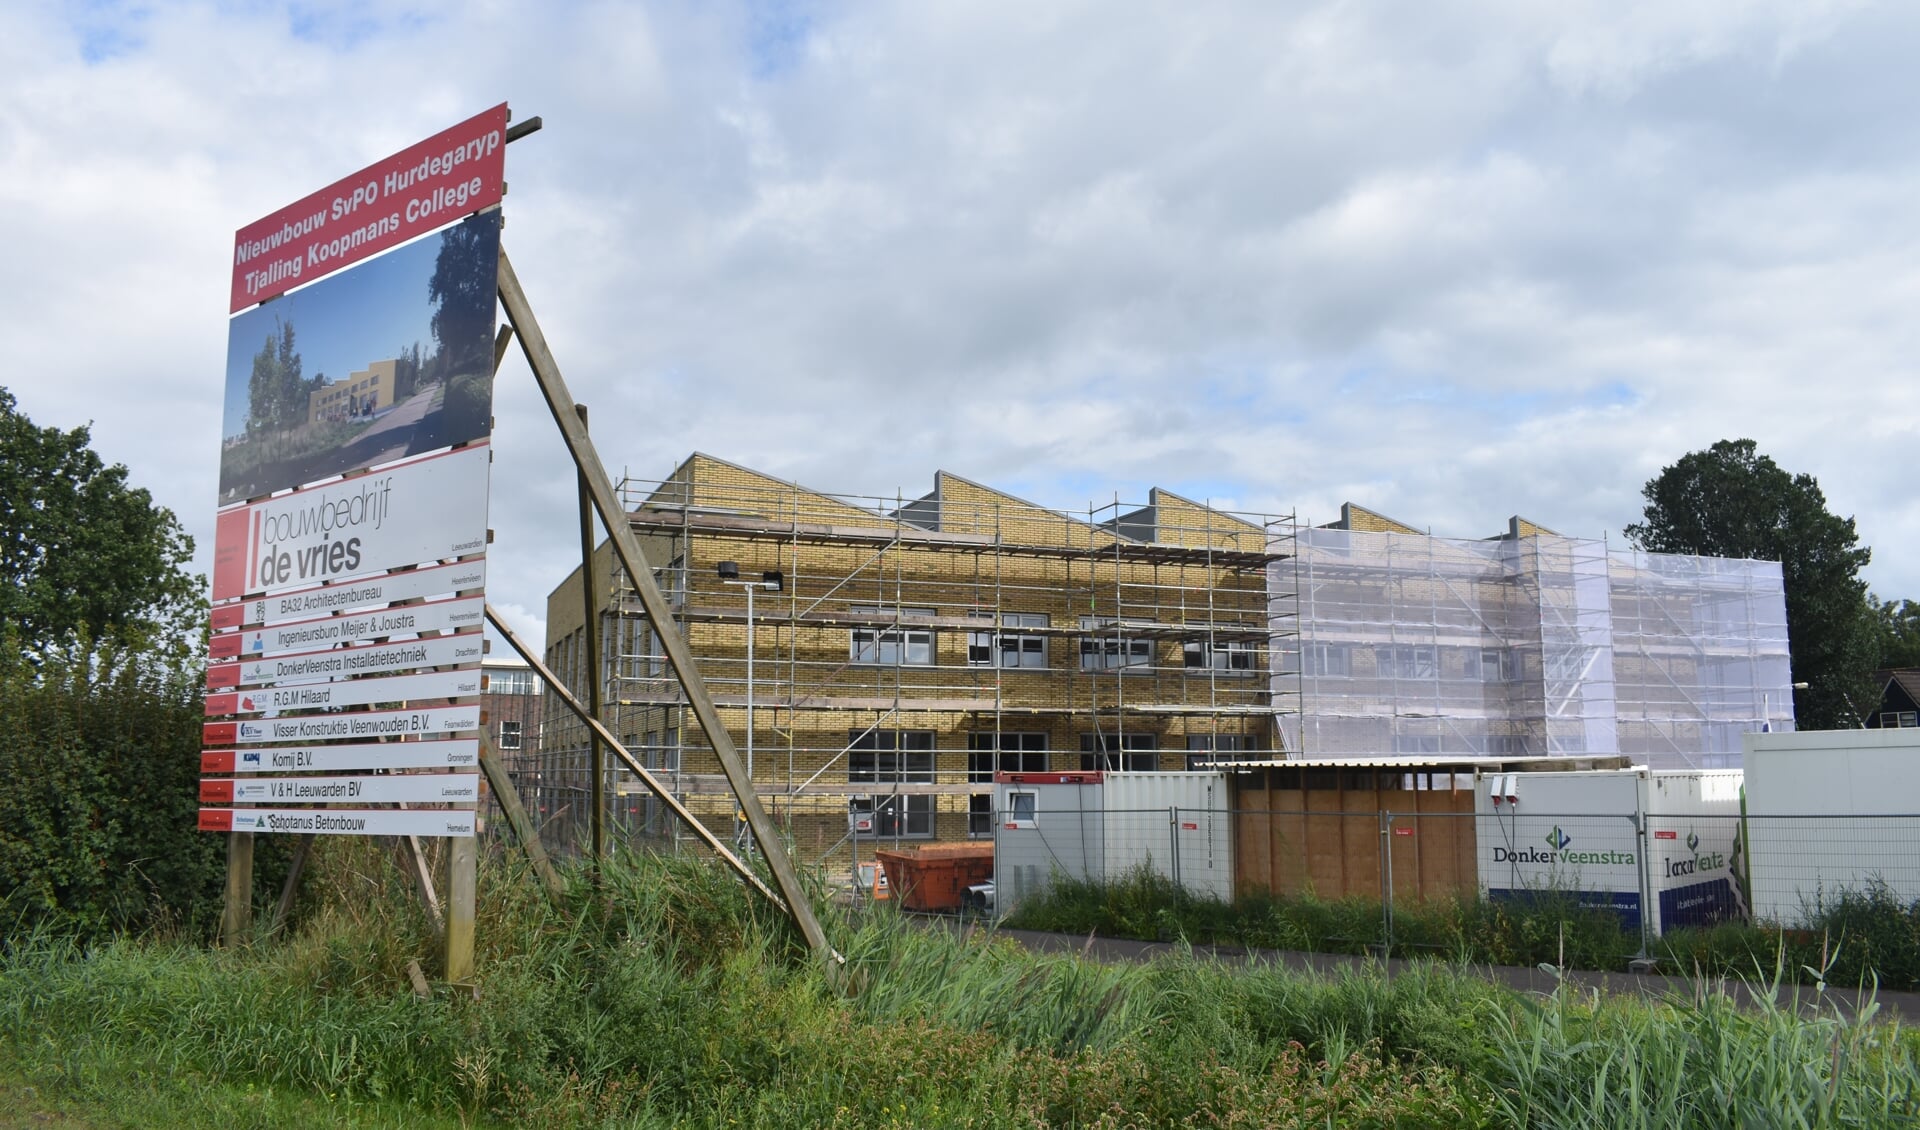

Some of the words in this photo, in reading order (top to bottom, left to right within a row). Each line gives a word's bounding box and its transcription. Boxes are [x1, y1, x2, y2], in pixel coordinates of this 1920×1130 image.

[236, 208, 327, 265] Nieuwbouw
[332, 181, 378, 220] SvPO
[384, 129, 500, 197] Hurdegaryp
[245, 254, 302, 296] Tjalling
[307, 211, 400, 267] Koopmans
[406, 177, 482, 223] College
[263, 476, 393, 545] bouwbedrijf
[451, 538, 483, 552] Leeuwarden
[261, 543, 292, 587] de
[297, 532, 362, 580] vries
[280, 597, 302, 614] BA32
[303, 586, 383, 611] Architectenbureau
[278, 625, 338, 648] Ingenieursburo
[340, 619, 369, 638] Meijer
[370, 620, 377, 632] &
[378, 614, 415, 632] Joustra
[276, 657, 342, 677] DonkerVeenstra
[343, 645, 428, 670] Installatietechniek
[455, 647, 479, 658] Drachten
[274, 690, 299, 707] R.G.M
[301, 688, 331, 704] Hilaard
[273, 723, 299, 738] Visser
[300, 720, 348, 737] Konstruktie
[349, 716, 409, 735] Veenwouden
[411, 714, 430, 731] B.V.
[272, 752, 295, 770] Komij
[297, 751, 313, 767] B.V.
[447, 753, 474, 764] Groningen
[270, 782, 277, 797] V
[278, 783, 284, 797] &
[286, 783, 293, 797] H
[294, 782, 346, 797] Leeuwarden
[348, 781, 362, 797] BV
[441, 787, 473, 797] Leeuwarden
[269, 814, 313, 830] Schotanus
[315, 814, 366, 831] Betonbouw
[446, 822, 471, 833] Hemelum
